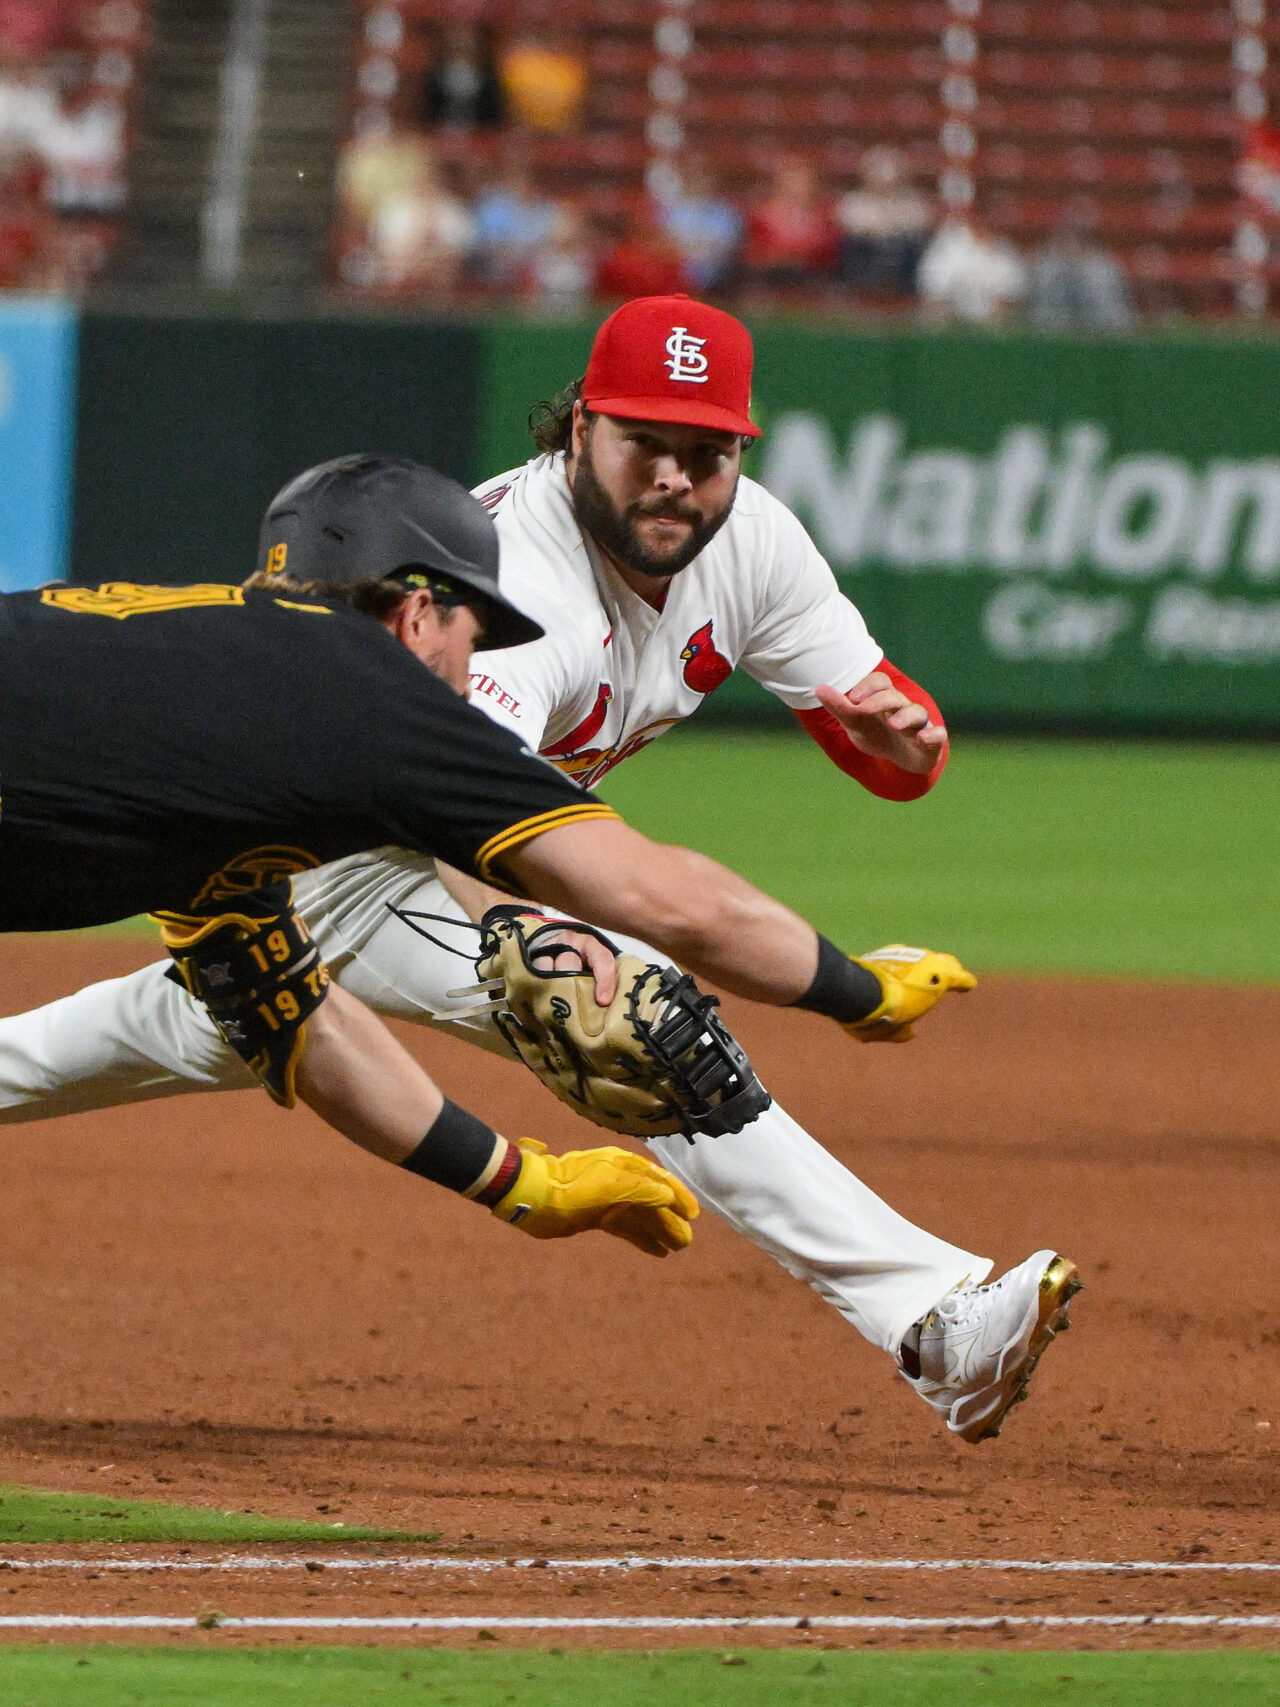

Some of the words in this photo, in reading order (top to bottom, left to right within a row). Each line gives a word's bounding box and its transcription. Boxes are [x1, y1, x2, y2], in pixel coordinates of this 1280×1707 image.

[266, 542, 288, 574] 19
[248, 929, 291, 972] 19
[257, 989, 301, 1031] 19
